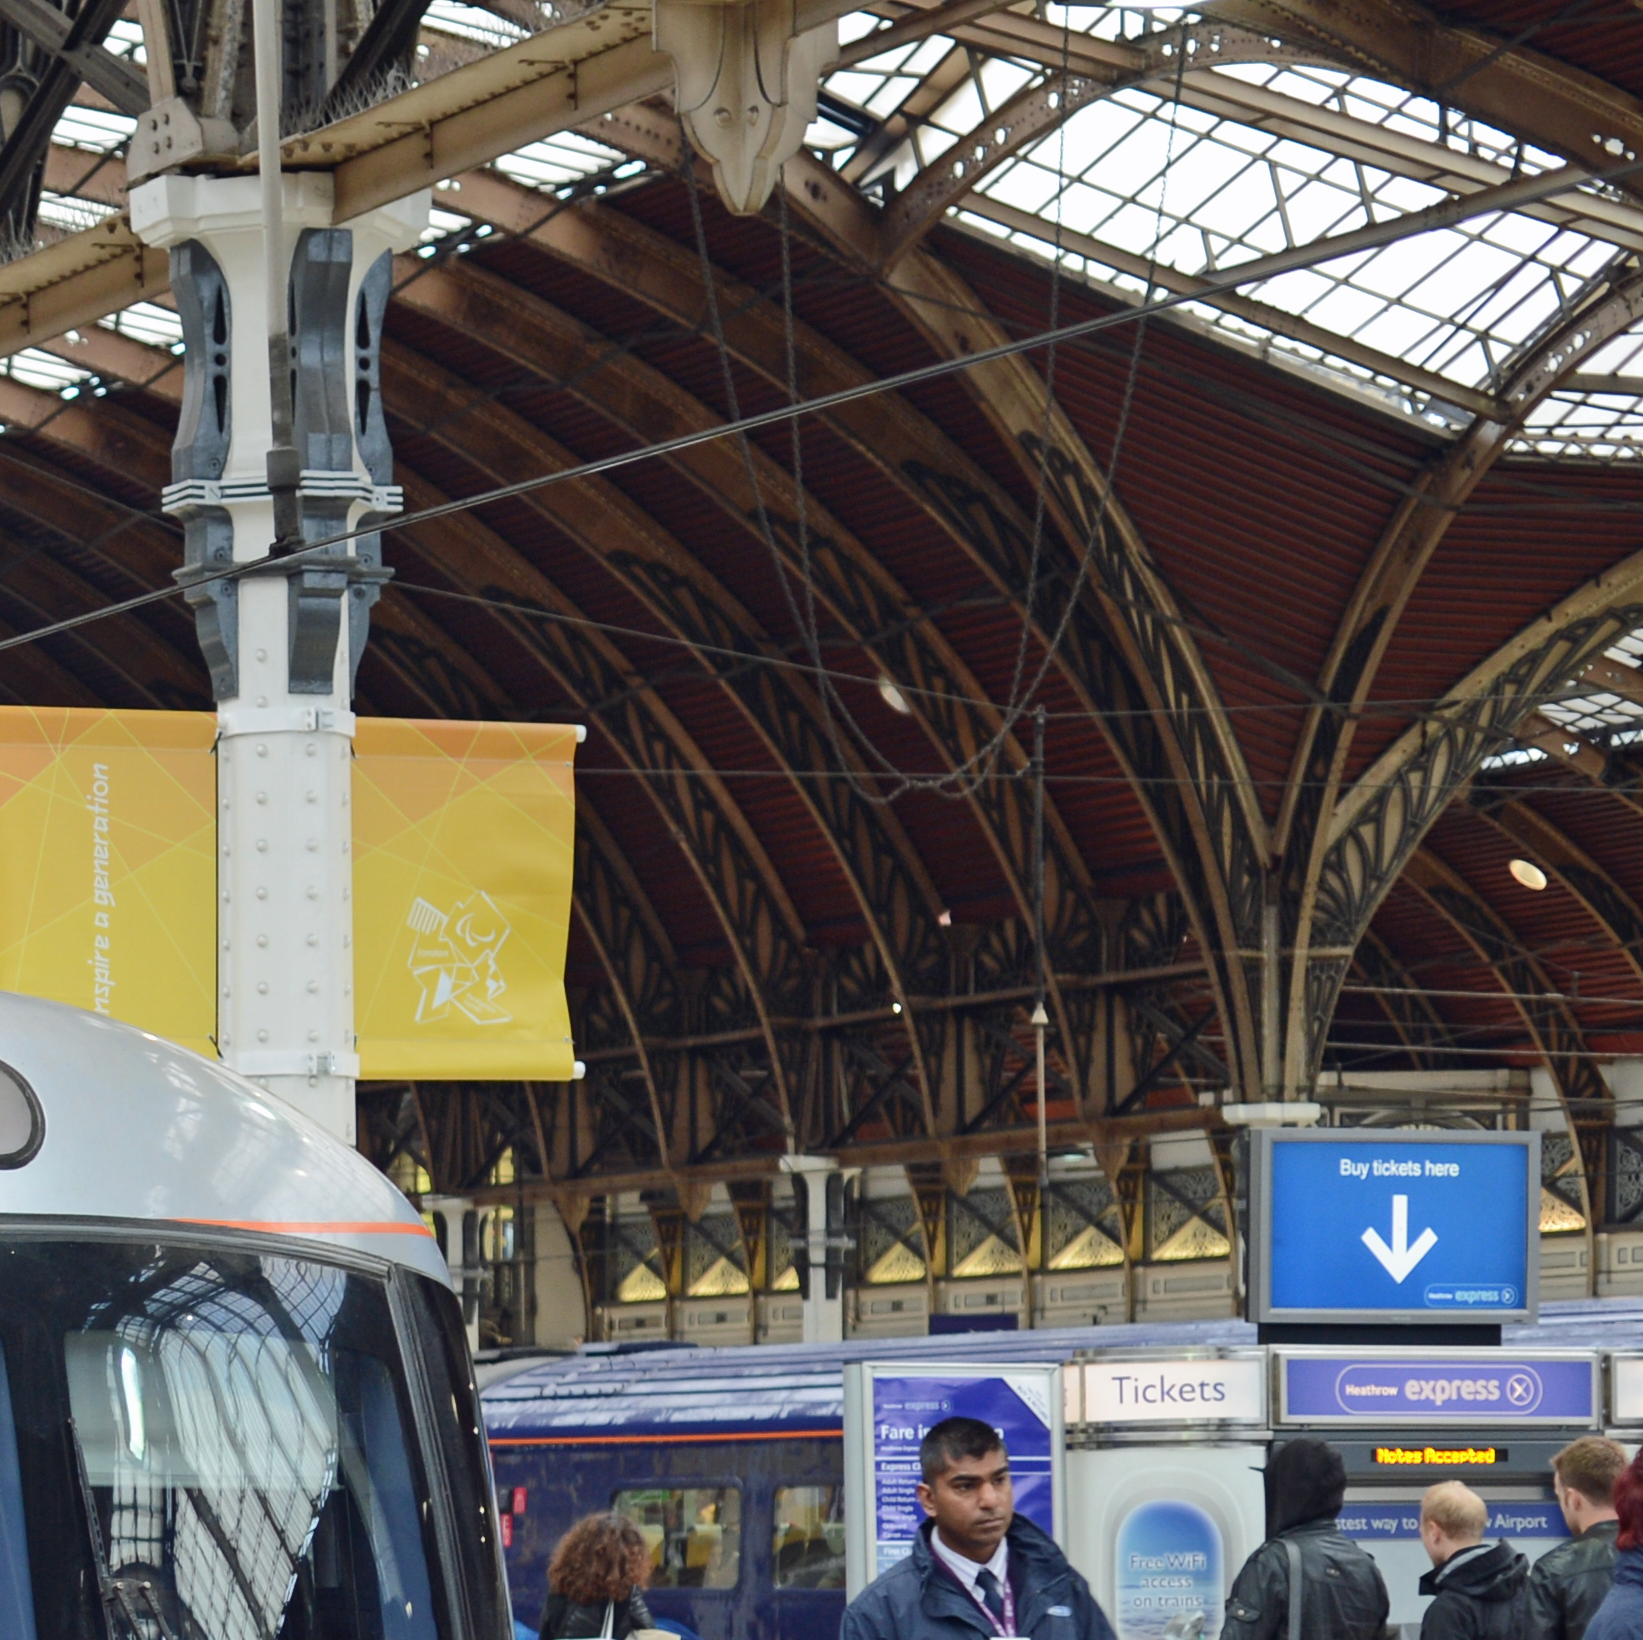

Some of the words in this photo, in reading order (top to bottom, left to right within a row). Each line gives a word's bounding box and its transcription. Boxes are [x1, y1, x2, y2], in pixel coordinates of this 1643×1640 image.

[87, 763, 116, 907] generation
[95, 912, 110, 927] a
[88, 935, 116, 1014] nspire
[1340, 1158, 1370, 1180] Buy
[1373, 1160, 1421, 1177] tickets
[1425, 1160, 1460, 1177] here
[1456, 1289, 1499, 1304] express
[1112, 1376, 1226, 1404] Tickets
[1346, 1382, 1398, 1397] Heathrow
[1405, 1377, 1500, 1405] express
[881, 1424, 914, 1440] Fare
[1376, 1448, 1422, 1464] Notes
[1425, 1447, 1496, 1465] Accepted
[1335, 1517, 1367, 1530] stest
[1374, 1519, 1398, 1534] way
[1402, 1517, 1417, 1530] to
[1495, 1514, 1548, 1533] Airport
[1130, 1554, 1164, 1569] Free
[1166, 1553, 1206, 1569] WiFi
[1142, 1577, 1192, 1588] access
[1133, 1597, 1152, 1607] on
[1158, 1596, 1202, 1607] trains
